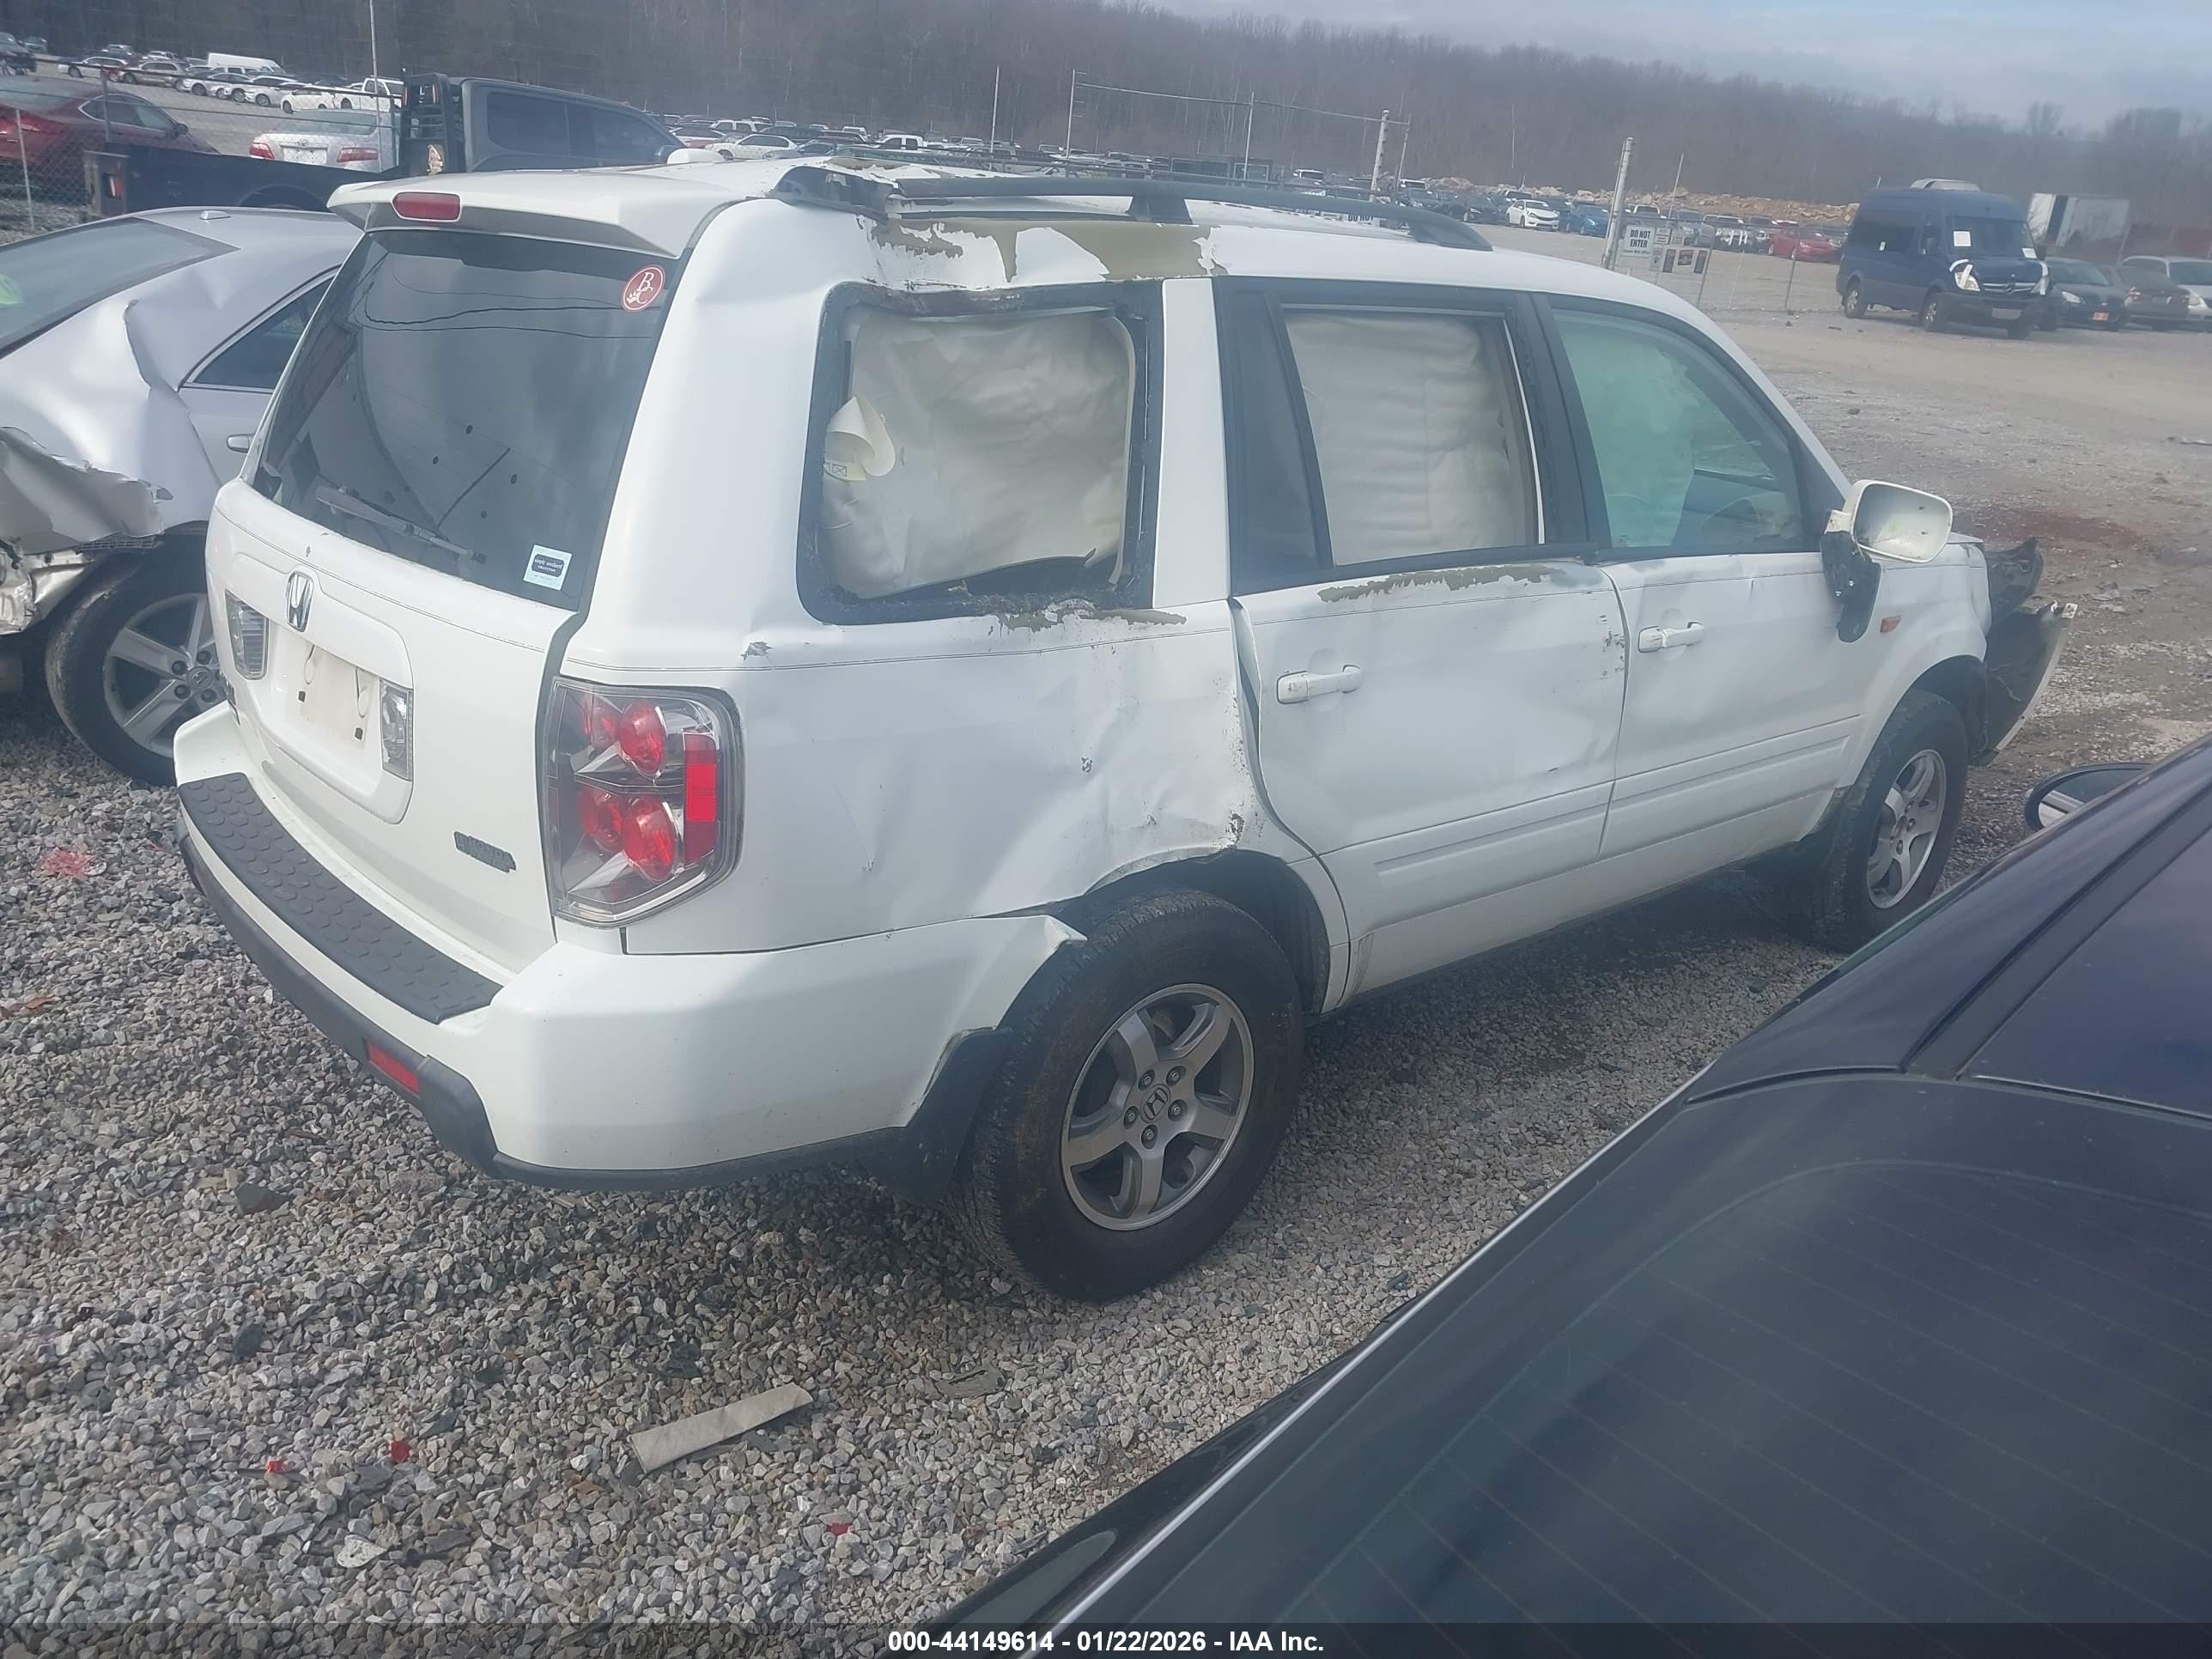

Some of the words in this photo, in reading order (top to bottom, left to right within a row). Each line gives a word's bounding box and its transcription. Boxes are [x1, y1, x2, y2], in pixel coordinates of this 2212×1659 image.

[1630, 229, 1638, 238] DO
[1639, 230, 1651, 240] NOT
[1630, 239, 1648, 248] ENTER
